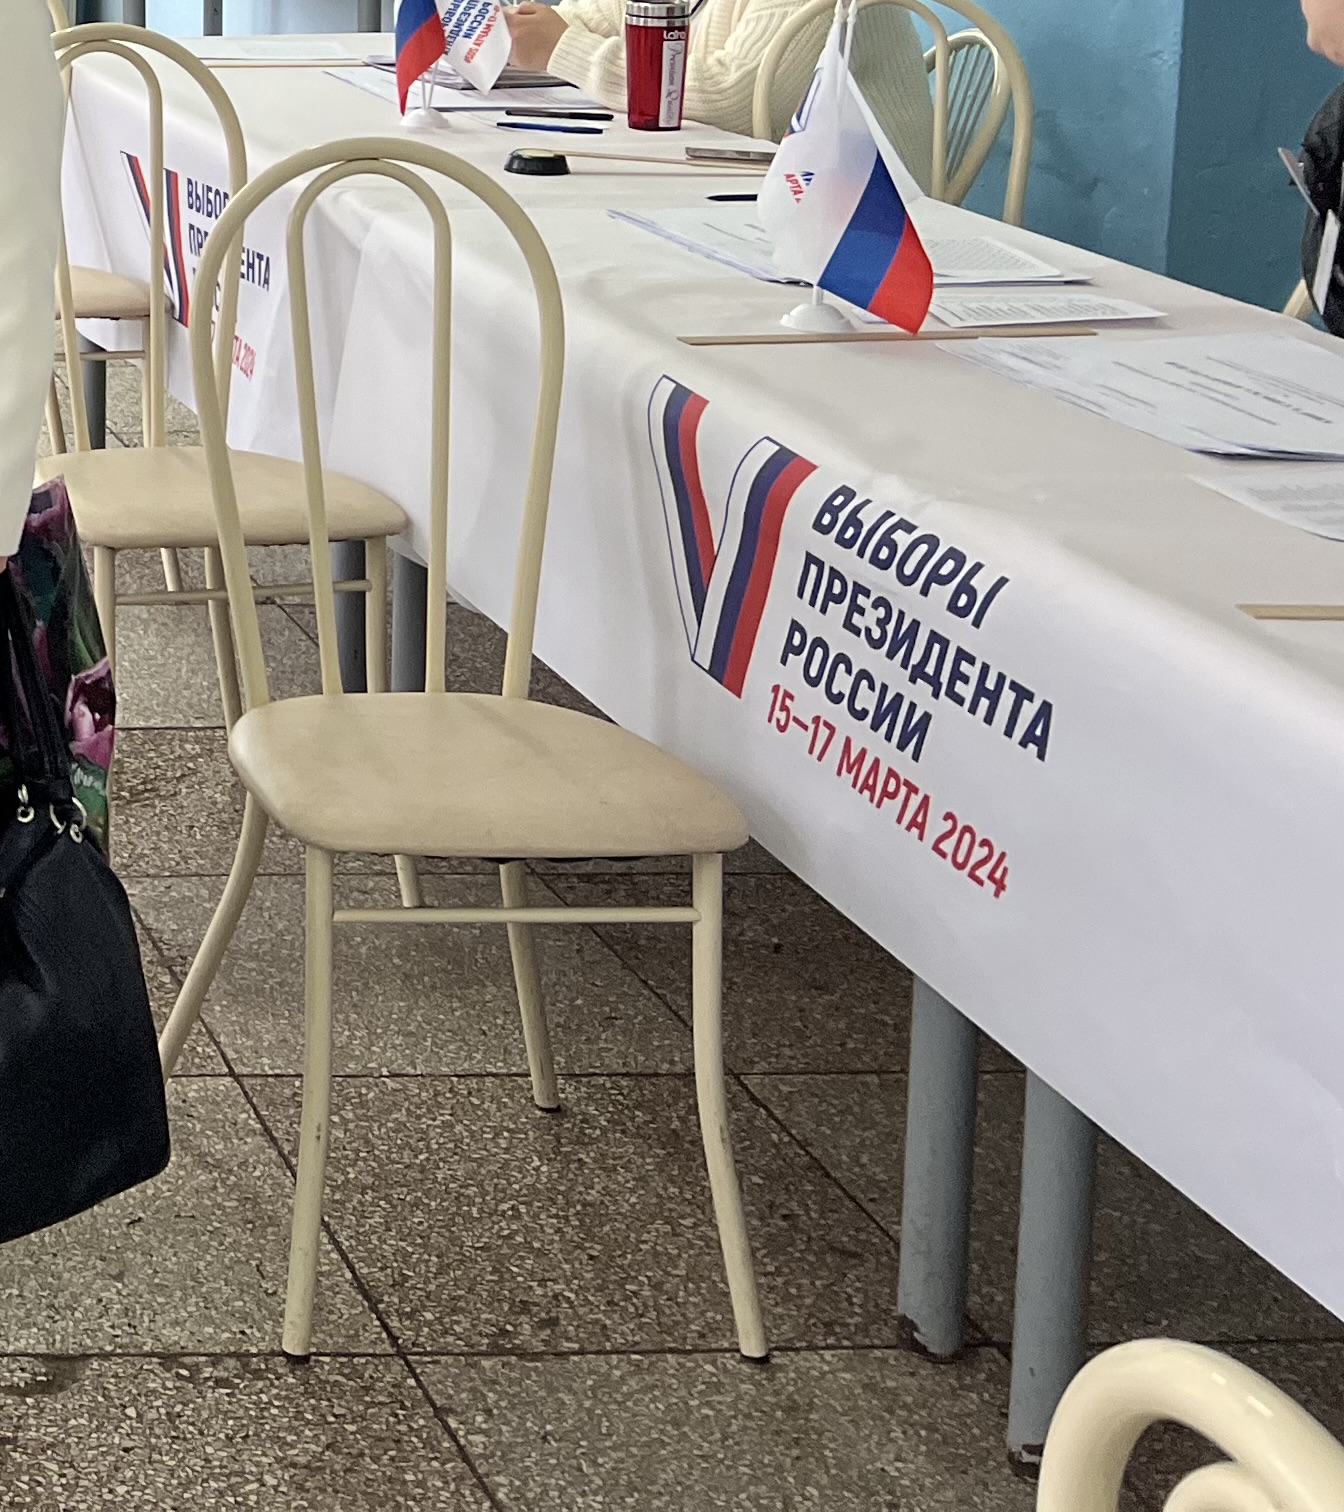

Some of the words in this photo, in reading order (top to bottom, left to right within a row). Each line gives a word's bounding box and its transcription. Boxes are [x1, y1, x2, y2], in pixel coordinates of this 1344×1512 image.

[811, 485, 1010, 629] ВЫБОРЫ
[780, 618, 933, 763] РОССИИ
[796, 550, 1054, 762] ПРЕЗИДЕНТА
[836, 736, 931, 842] МАРТА
[931, 811, 1009, 899] 2024
